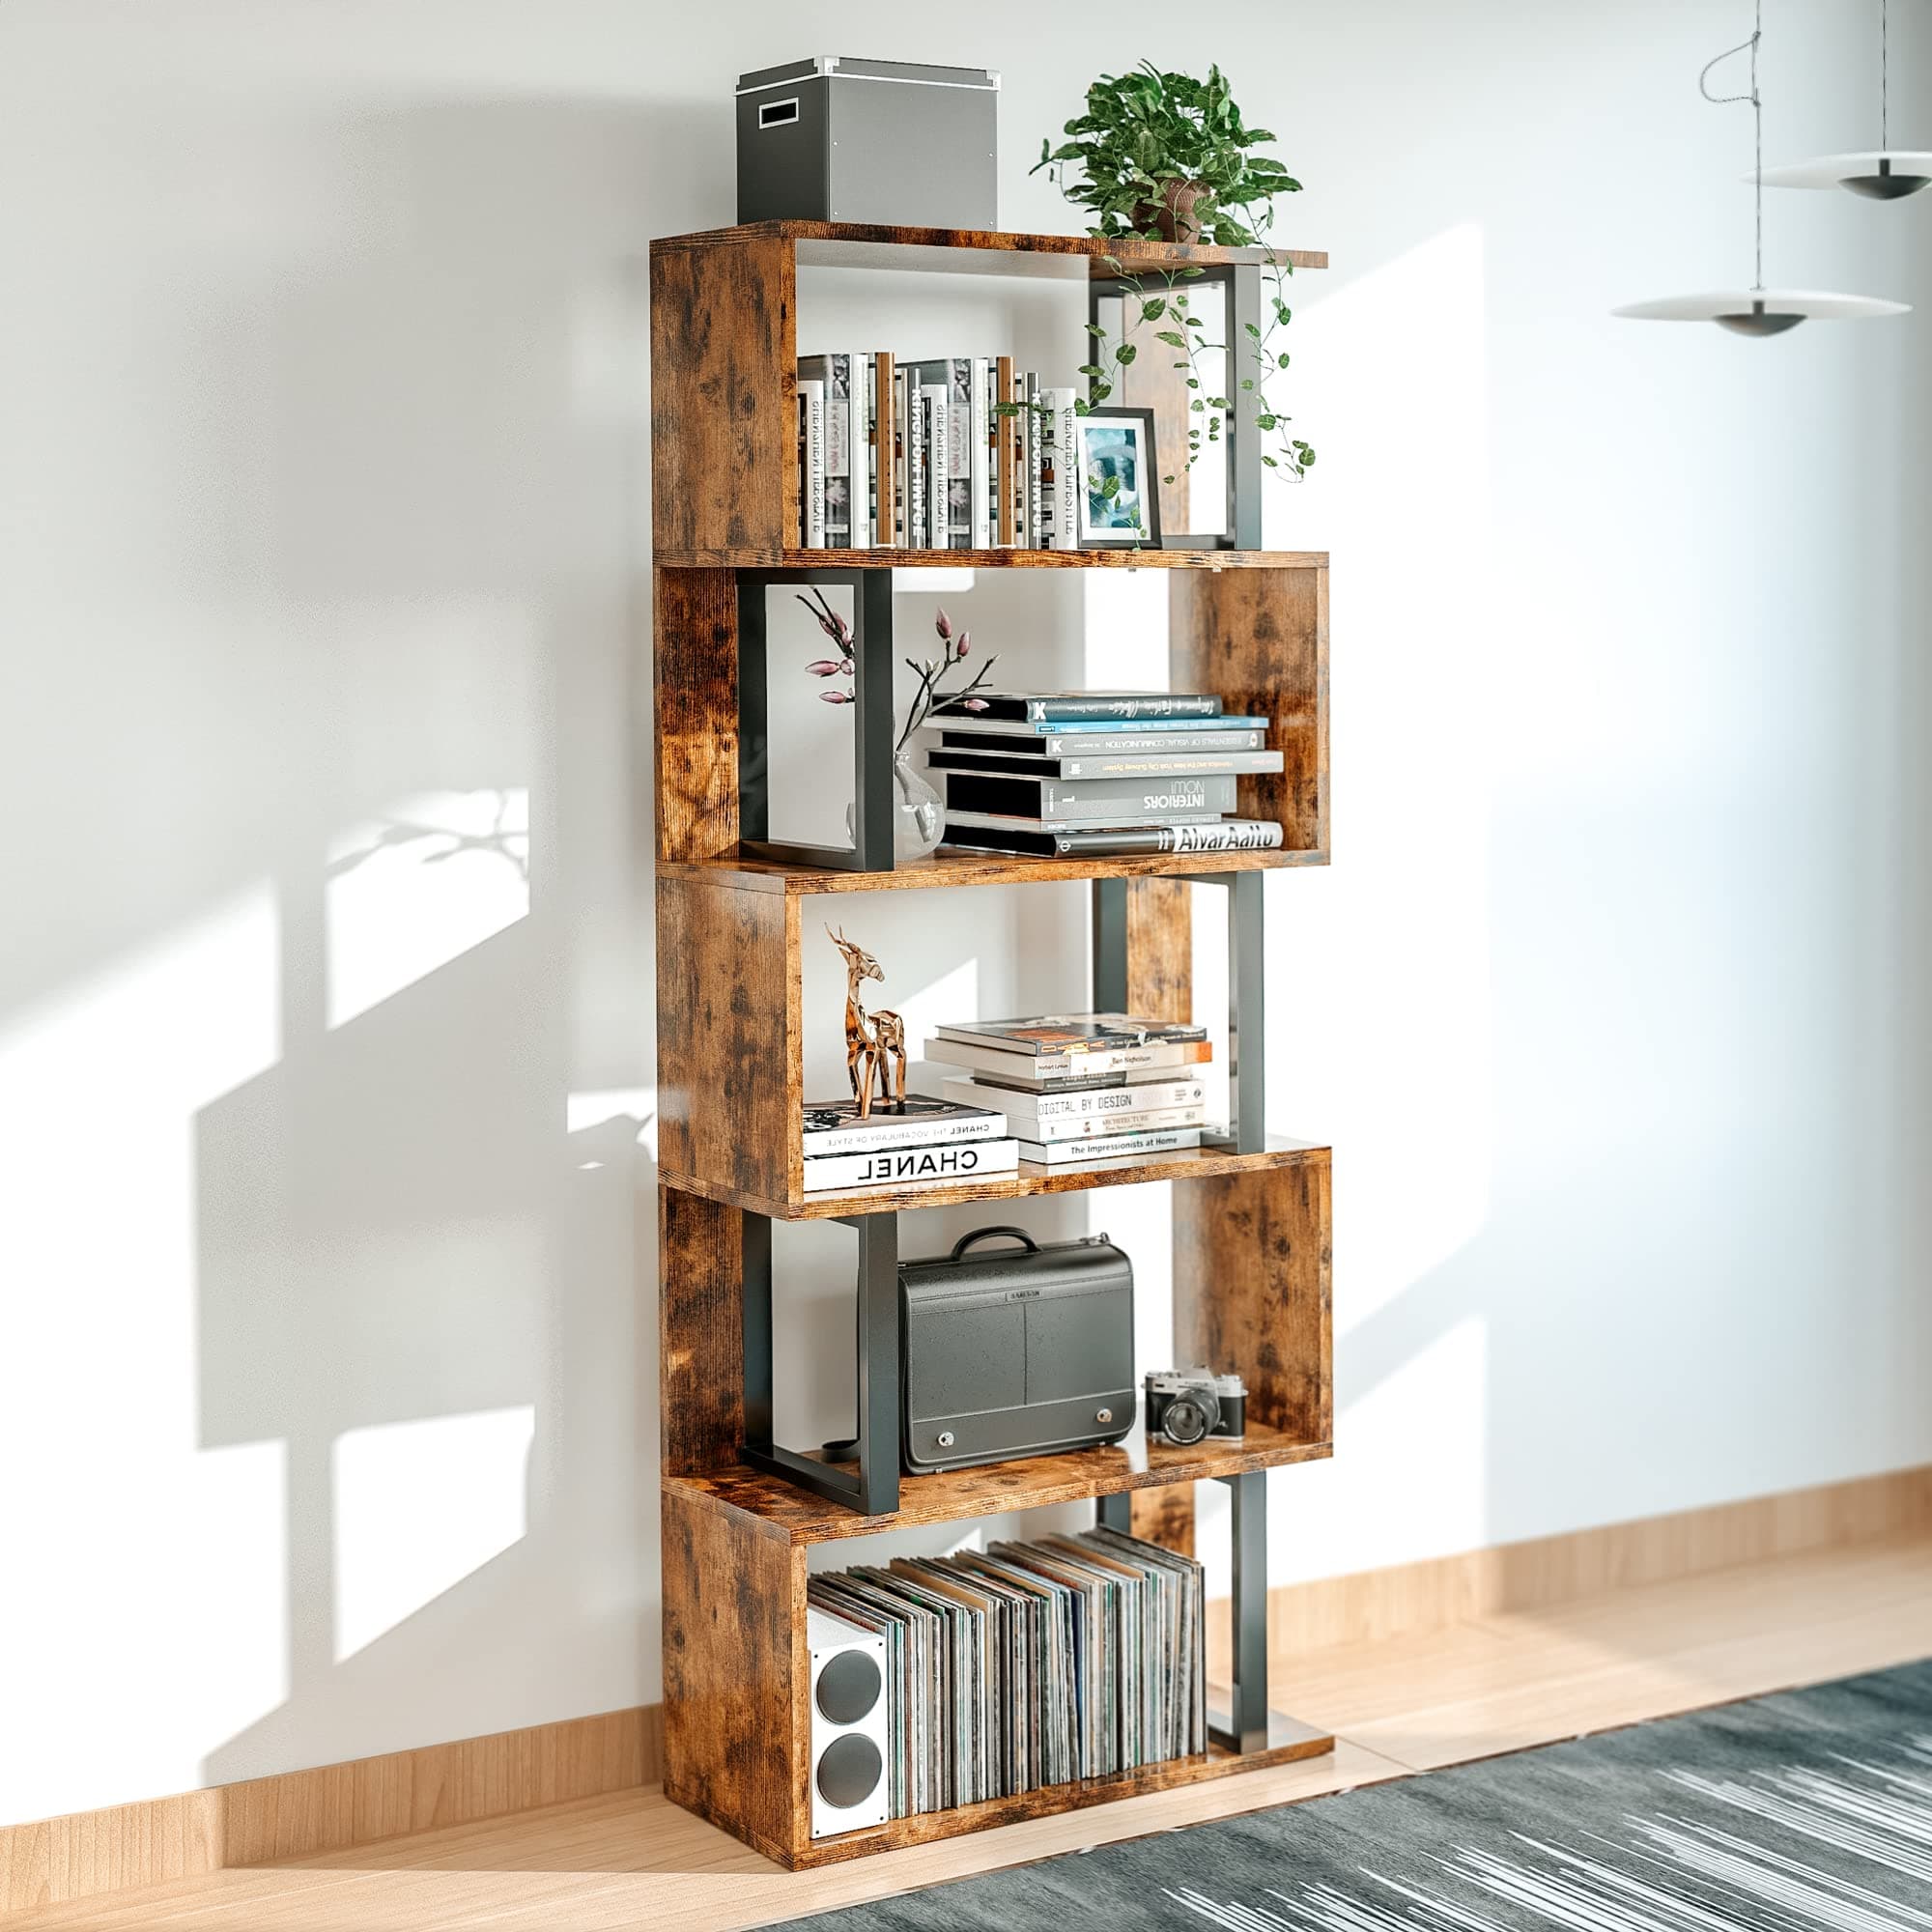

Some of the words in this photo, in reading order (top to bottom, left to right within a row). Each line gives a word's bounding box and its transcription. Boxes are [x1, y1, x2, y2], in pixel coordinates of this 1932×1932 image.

[1105, 738, 1165, 749] COMMUNICATION
[1170, 780, 1206, 793] NOW!
[1144, 794, 1206, 810] INTERIORS
[1179, 828, 1224, 851] Alvar
[1037, 1102, 1075, 1116] DIGITAL
[1081, 1099, 1093, 1111] BY
[1098, 1094, 1132, 1110] DESIGN
[1070, 1146, 1085, 1155] The
[1087, 1141, 1143, 1154] Impressionists
[1146, 1138, 1153, 1147] at
[1155, 1136, 1178, 1146] Home
